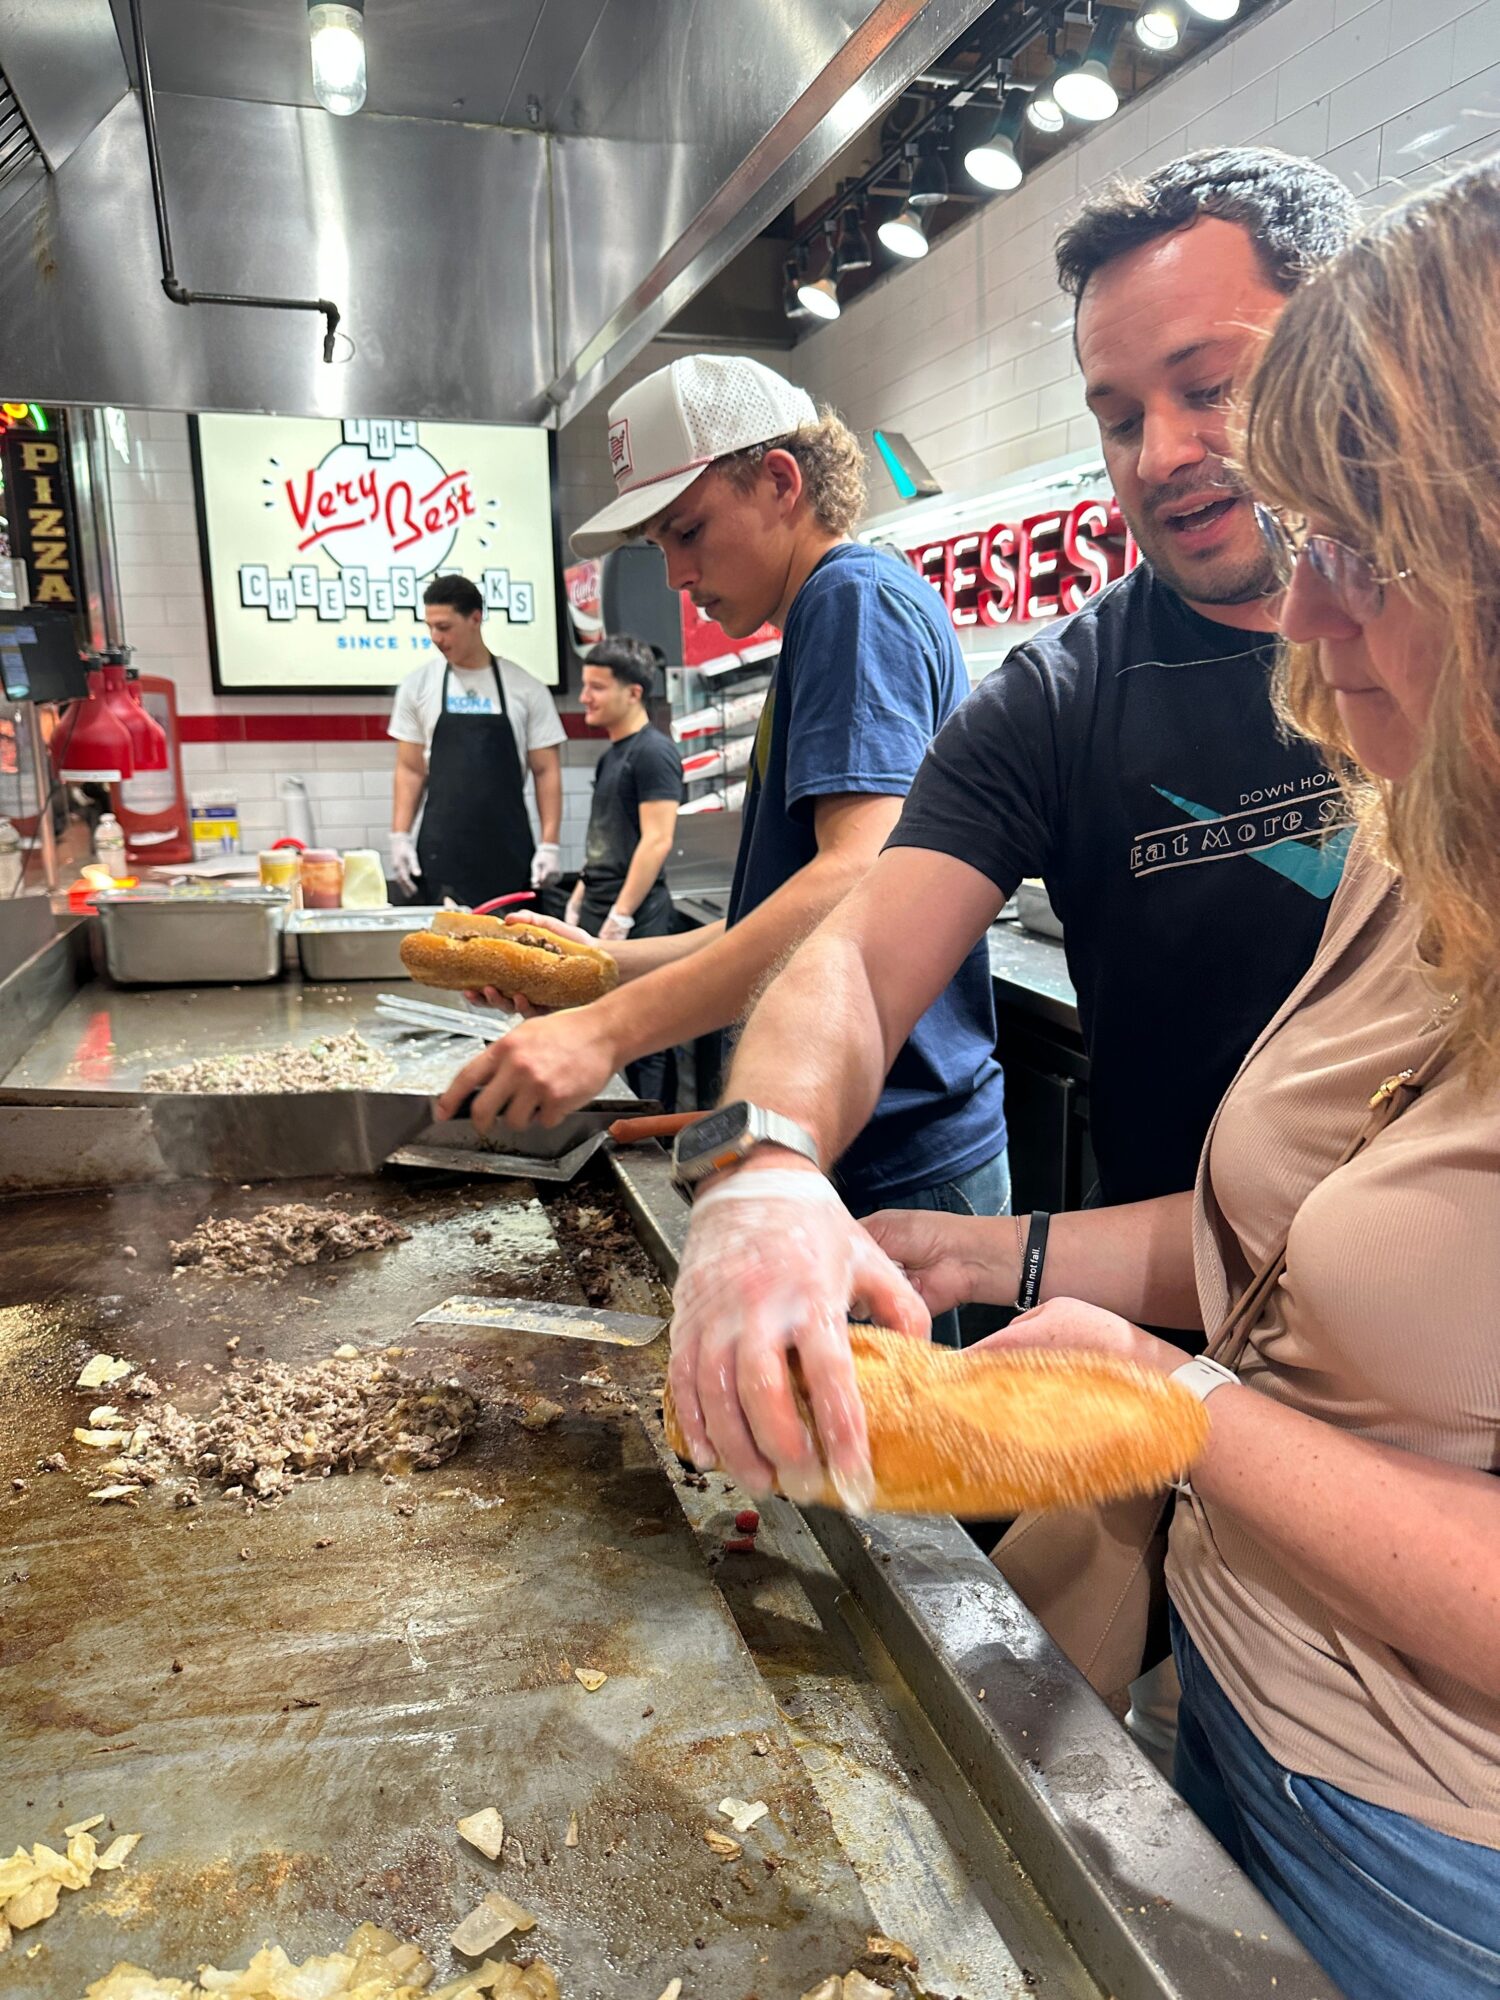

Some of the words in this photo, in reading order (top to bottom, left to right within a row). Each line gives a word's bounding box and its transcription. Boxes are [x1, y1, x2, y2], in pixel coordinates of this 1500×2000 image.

[21, 442, 76, 601] PIZZA
[285, 468, 380, 530] Very
[385, 471, 476, 552] Best
[905, 497, 1138, 630] EESES
[250, 574, 527, 613] CHEESESKS
[336, 636, 399, 650] SINCE
[411, 636, 433, 650] 19
[1239, 781, 1295, 806] DOWN
[1130, 834, 1190, 870] Eat
[1201, 810, 1303, 850] More
[1026, 1280, 1035, 1295] will
[1029, 1264, 1038, 1279] not
